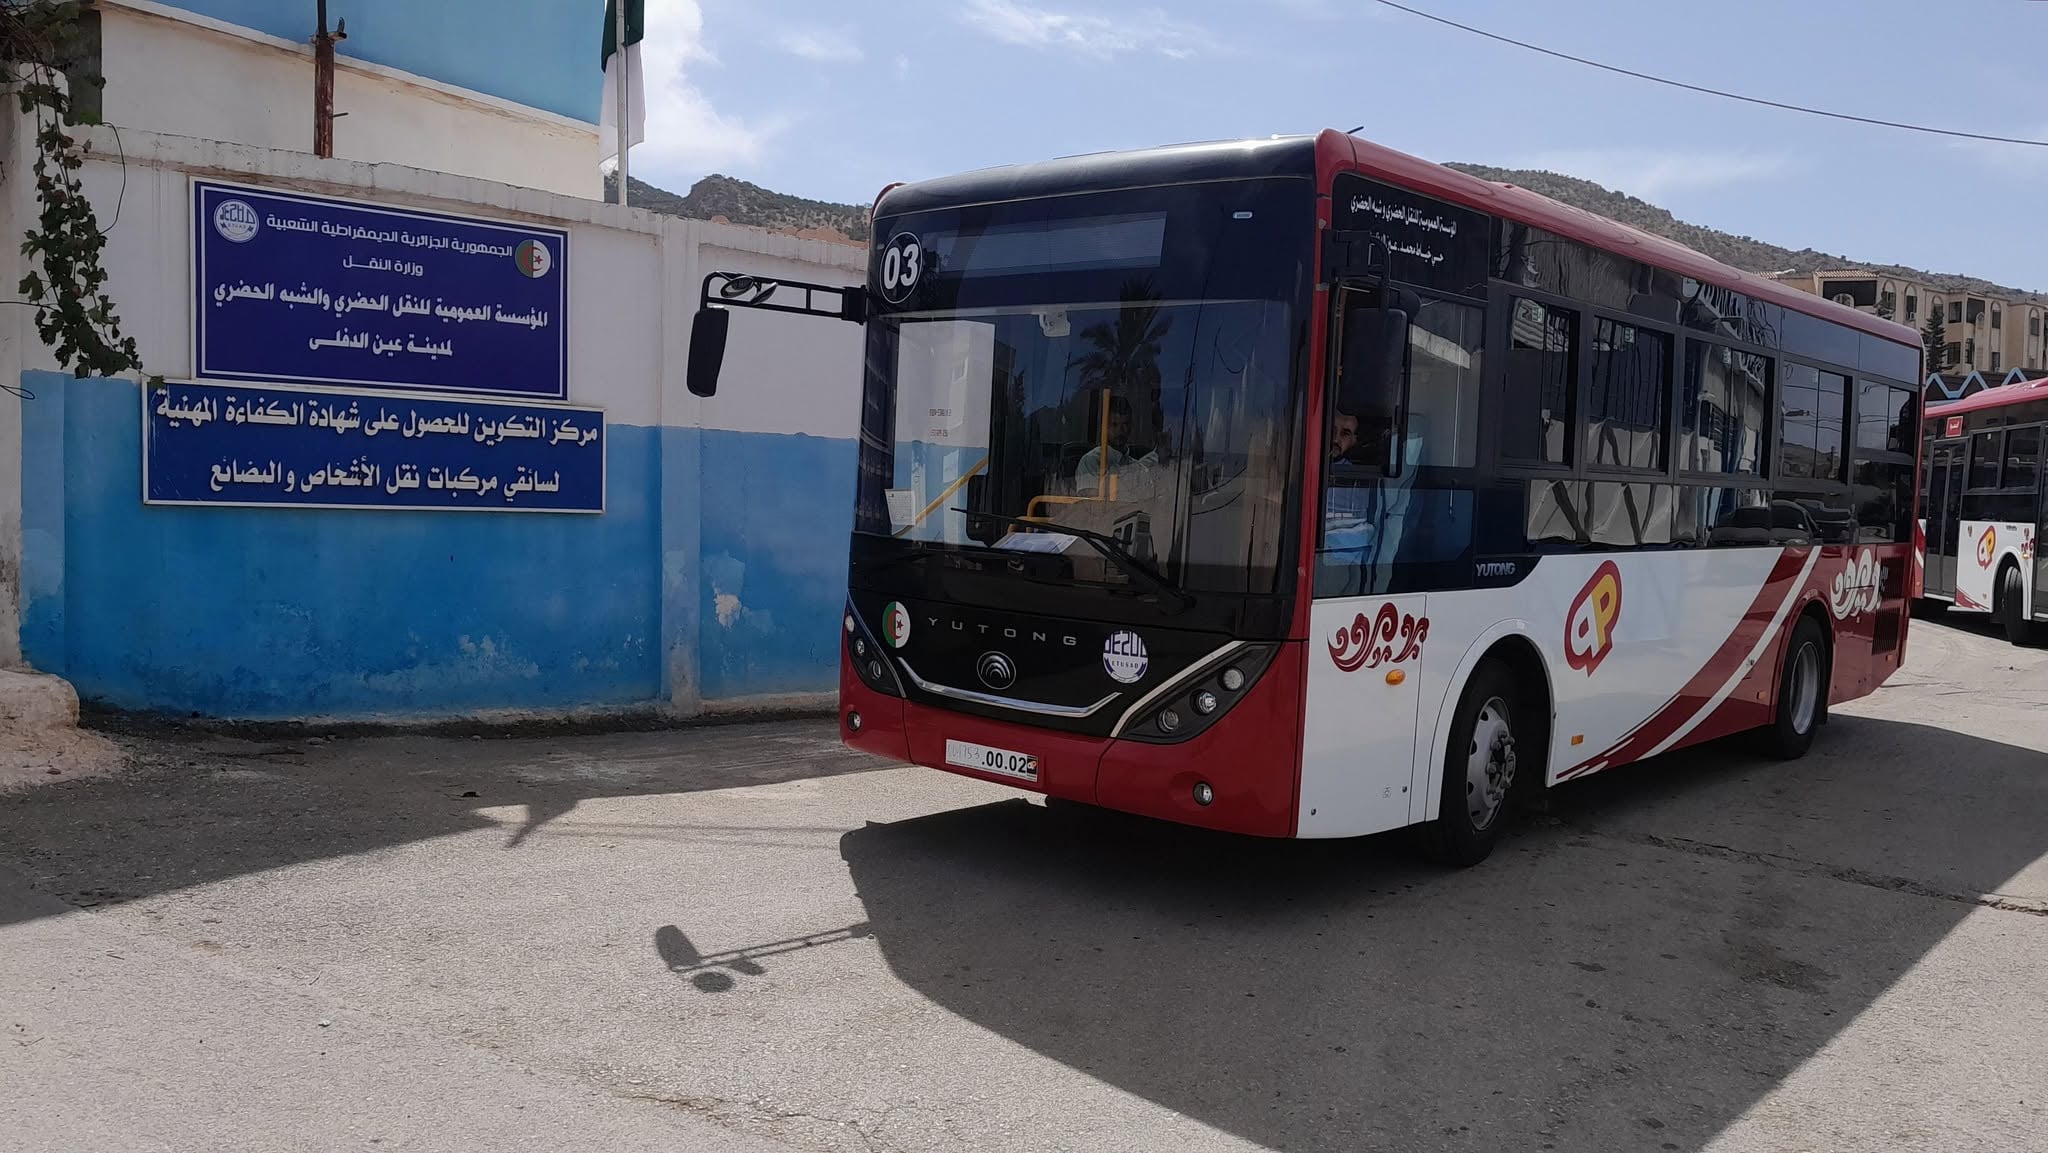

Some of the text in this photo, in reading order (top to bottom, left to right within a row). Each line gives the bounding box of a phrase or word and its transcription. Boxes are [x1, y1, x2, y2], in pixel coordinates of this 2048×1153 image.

[266, 213, 318, 233] الشعبية
[321, 220, 398, 243] الديمقراطية
[401, 231, 448, 248] الجزائرية
[451, 238, 512, 257] الجمهورية
[394, 258, 423, 276] وزارة
[884, 243, 918, 289] 03
[214, 280, 547, 330] المؤسسة العمومية للنقل الحضري والشبه الحضري
[309, 327, 453, 361] لمدينة عين الدفلى
[157, 389, 598, 446] مركز التكوين للحصول على شهادة الكفاءة المهنية
[300, 456, 380, 492] الأشخاص
[385, 465, 419, 493] نقل
[427, 465, 497, 497] مركبات
[503, 466, 560, 502] لسائقي
[1476, 562, 1516, 577] YUTONG
[928, 617, 1078, 646] YUTONG
